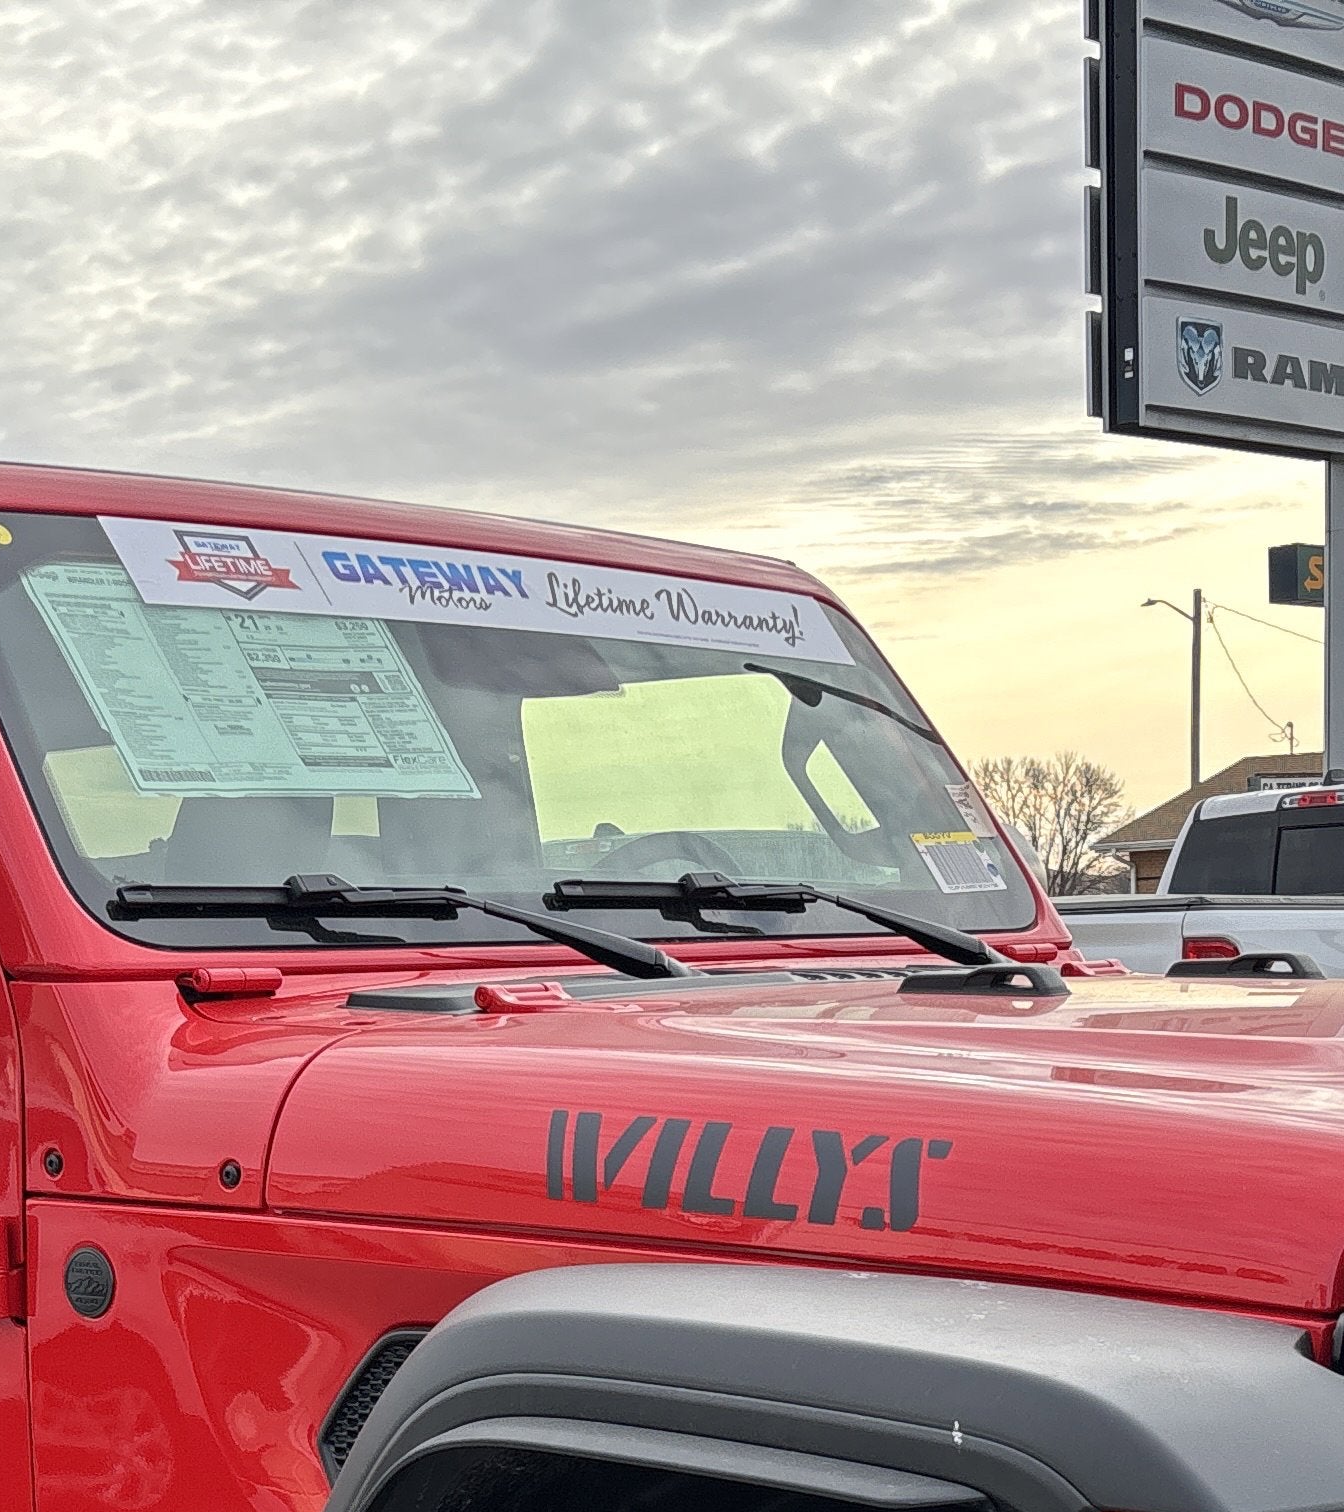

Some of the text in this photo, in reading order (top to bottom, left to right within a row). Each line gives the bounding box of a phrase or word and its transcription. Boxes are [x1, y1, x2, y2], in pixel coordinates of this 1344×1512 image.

[1203, 196, 1325, 294] Jeep
[184, 553, 273, 576] LIFETIME
[193, 540, 241, 552] GATEWAY
[321, 550, 531, 599] GATEWAY
[399, 583, 493, 613] Motors
[545, 571, 806, 647] Lifetime Warranty!
[234, 613, 260, 631] 21
[546, 1109, 954, 1232] WILLYS
